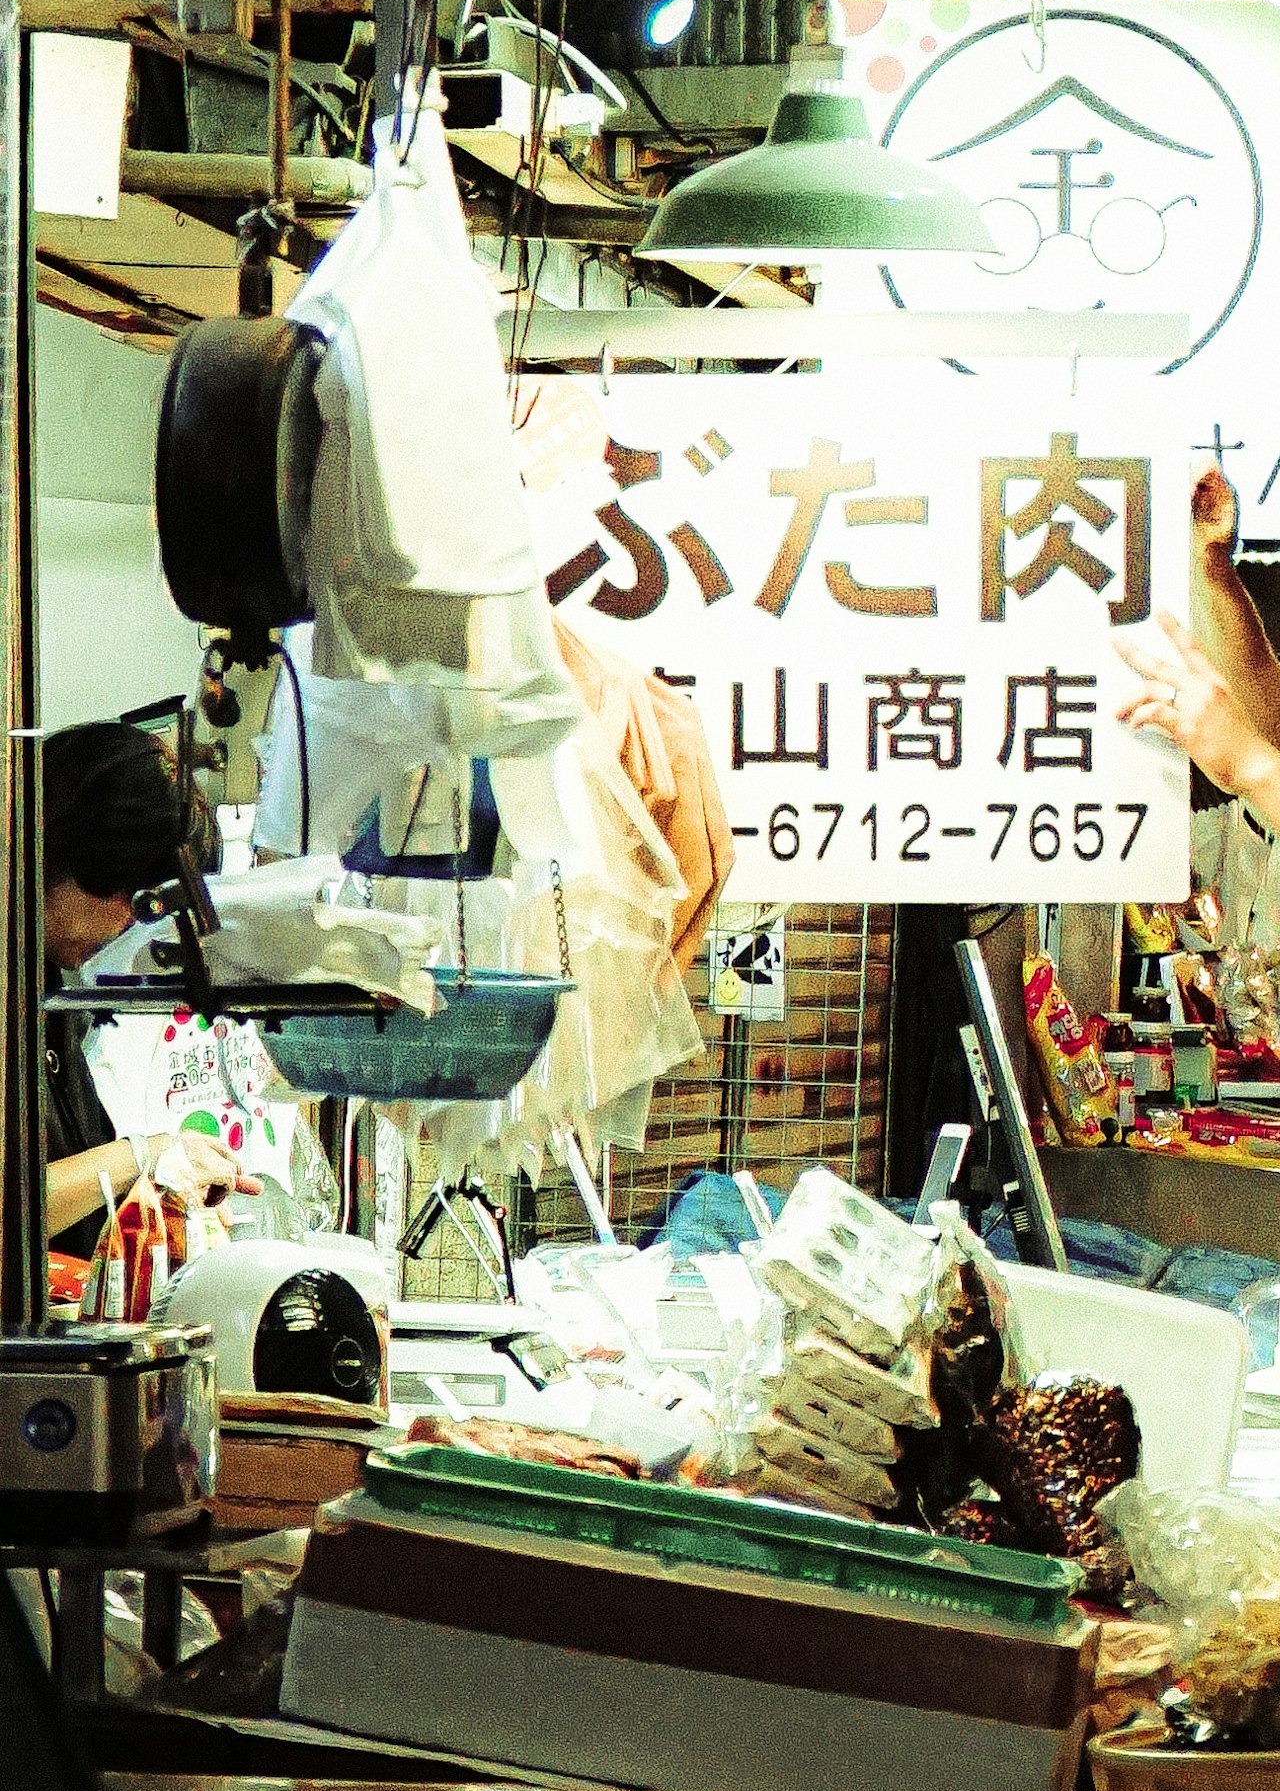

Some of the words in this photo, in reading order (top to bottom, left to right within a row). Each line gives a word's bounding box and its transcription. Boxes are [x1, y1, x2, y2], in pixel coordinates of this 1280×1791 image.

[545, 428, 1152, 628] ぶた肉
[652, 666, 1097, 773] 山商店
[732, 803, 1149, 863] -6712-7657
